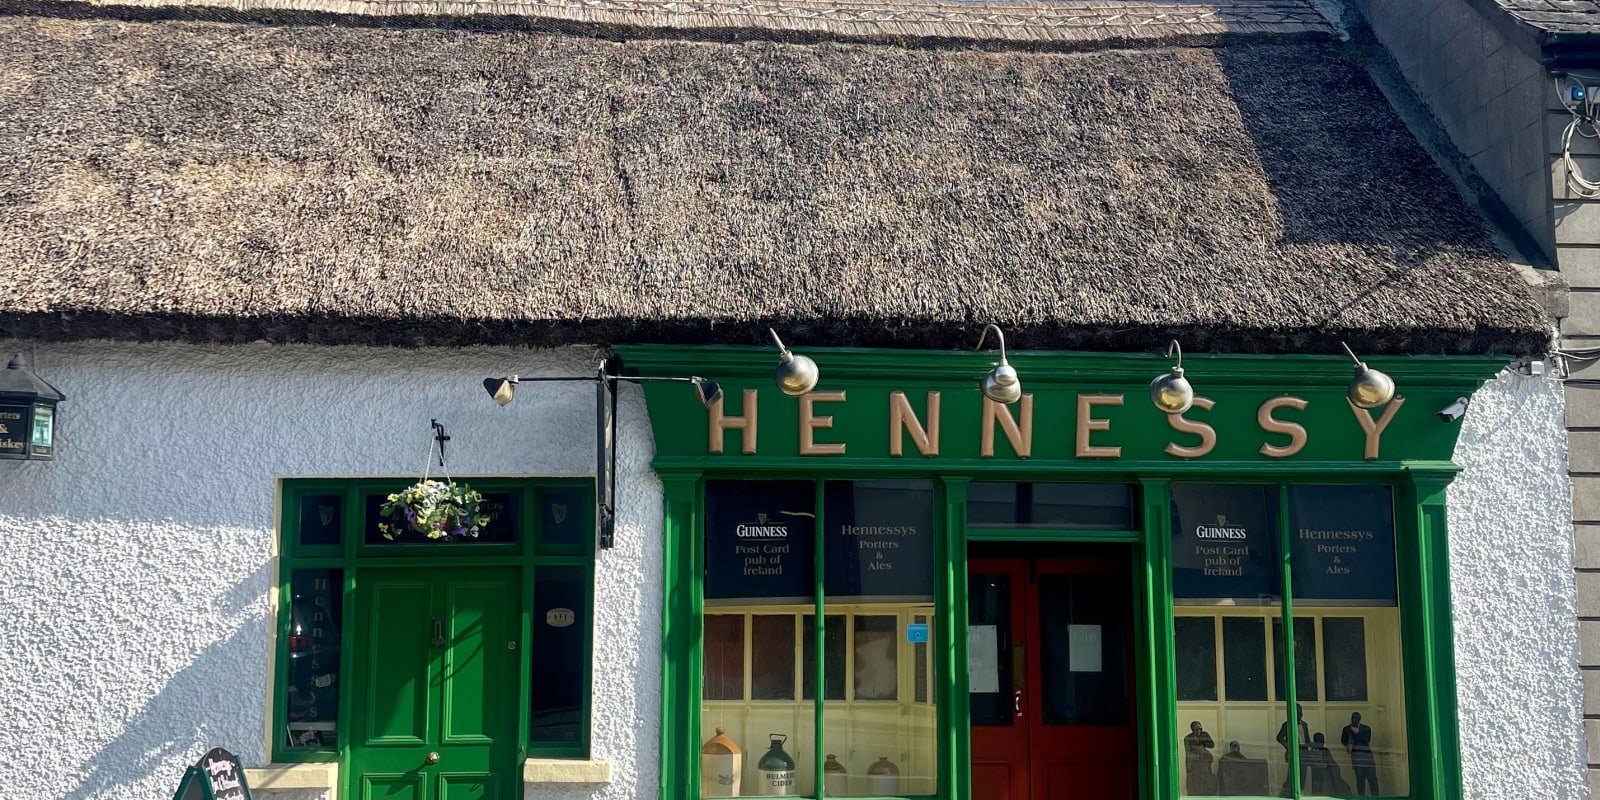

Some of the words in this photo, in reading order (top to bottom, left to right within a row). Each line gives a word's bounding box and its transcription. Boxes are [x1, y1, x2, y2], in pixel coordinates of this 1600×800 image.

[708, 388, 1406, 460] HENNESSY
[736, 524, 788, 538] GUINNESS
[841, 524, 917, 537] Hennessys
[1196, 526, 1247, 539] GUINNESS
[1299, 528, 1374, 542] Hennessys
[735, 545, 760, 554] Post
[763, 544, 790, 554] Card
[859, 540, 899, 549] Porters
[1195, 546, 1220, 555] Post
[1222, 545, 1249, 555] Card
[1317, 544, 1357, 553] Porters
[744, 554, 766, 567] pub
[769, 554, 781, 565] of
[875, 552, 884, 560] &
[1204, 556, 1226, 567] pub
[1229, 556, 1241, 566] of
[1333, 556, 1341, 564] &
[743, 565, 783, 576] Ireland
[867, 561, 892, 571] Ales
[1204, 566, 1242, 577] Ireland
[1326, 566, 1350, 575] Ales
